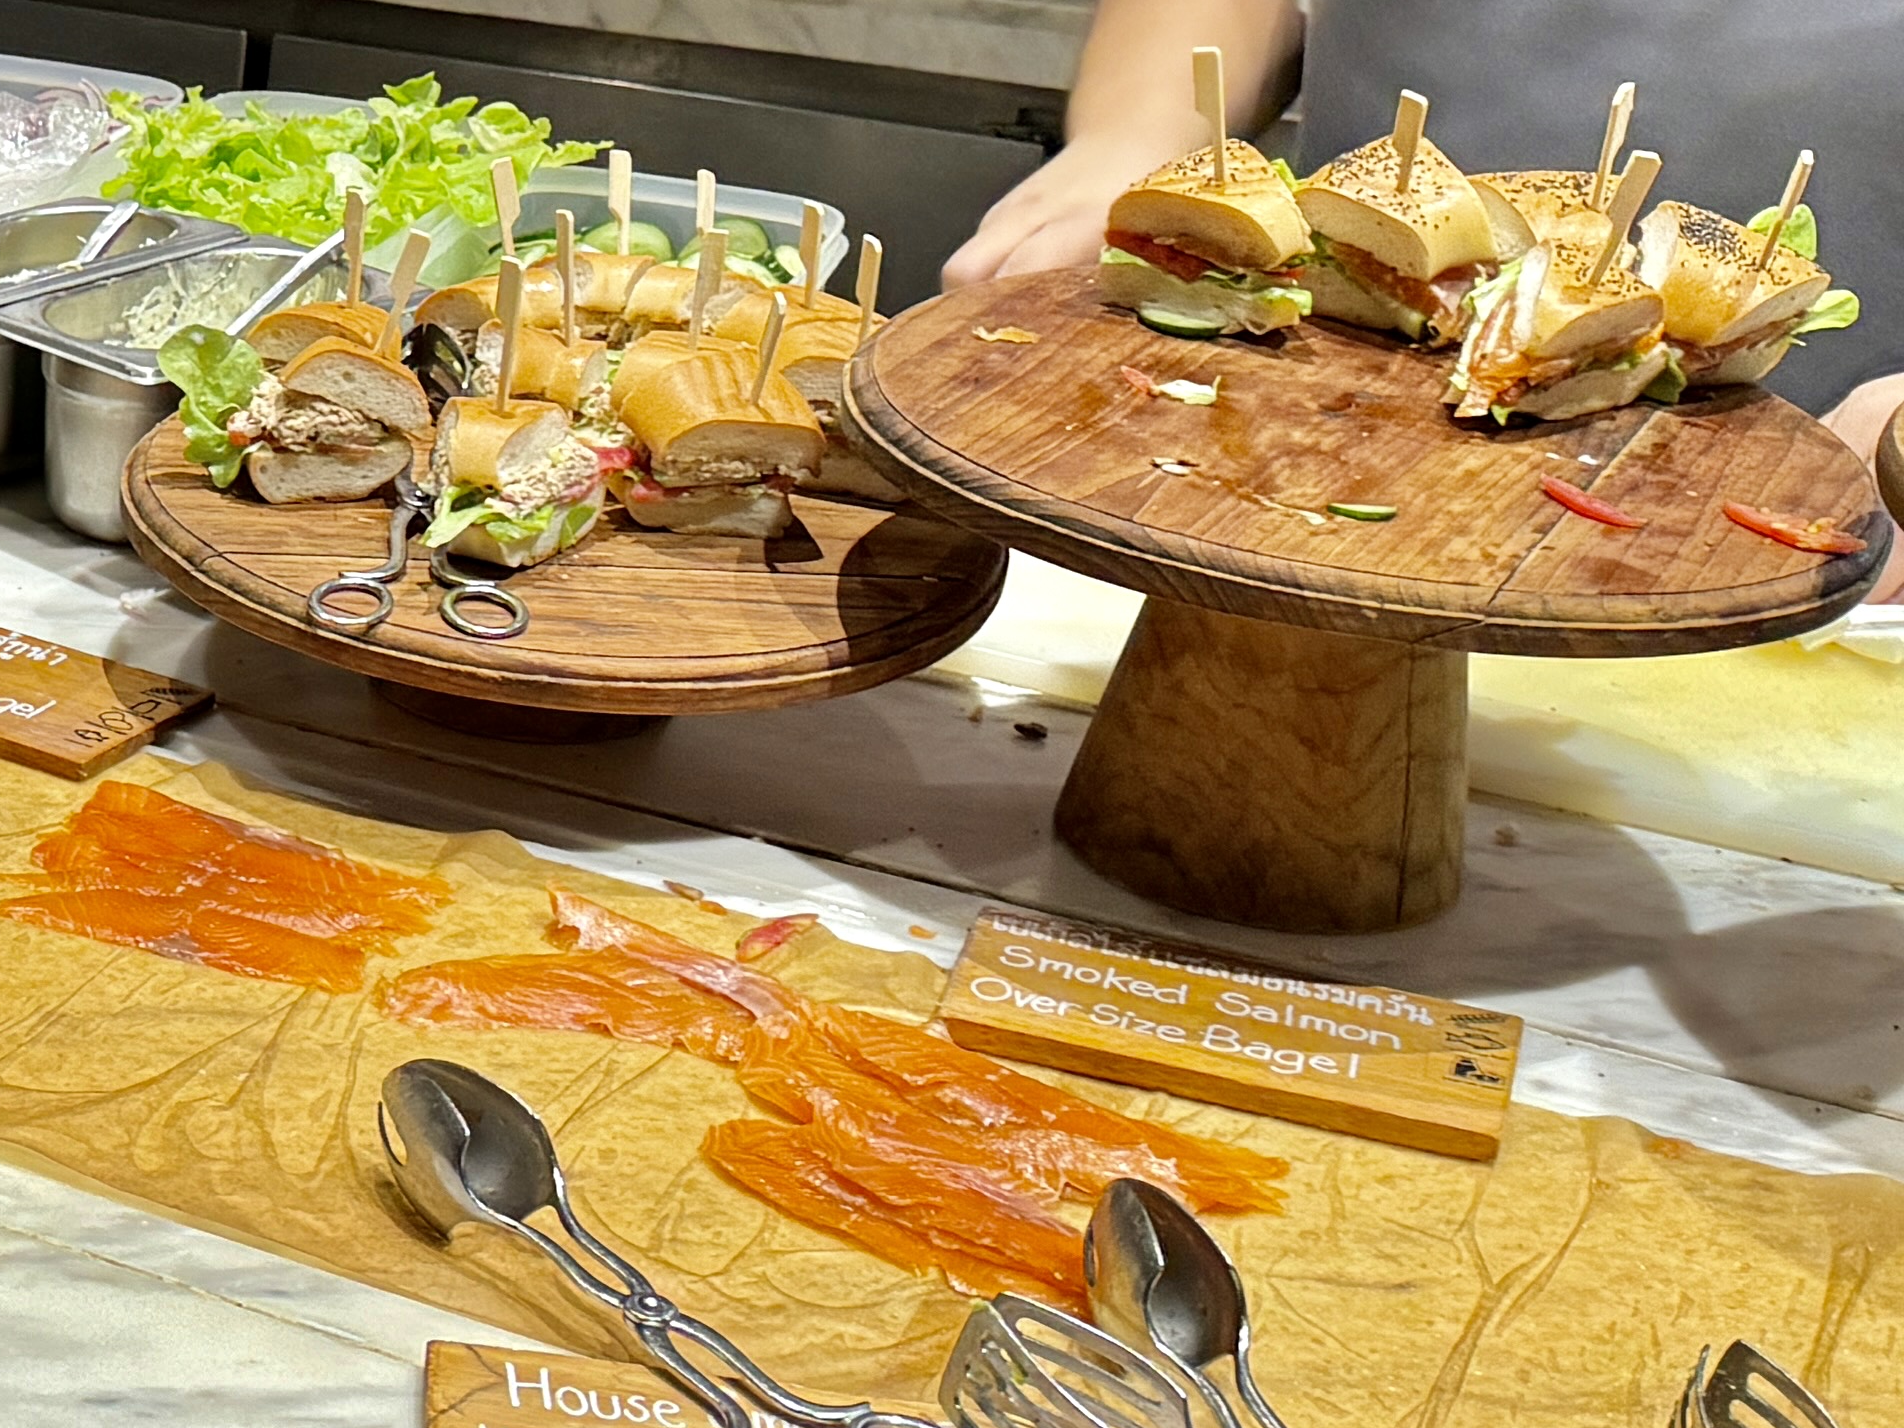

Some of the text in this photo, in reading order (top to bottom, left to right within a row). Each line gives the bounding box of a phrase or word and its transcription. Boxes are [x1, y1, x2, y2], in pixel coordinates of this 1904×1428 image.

[970, 975, 1359, 1079] Over Size Bagel
[999, 944, 1401, 1050] Smoked Salmon
